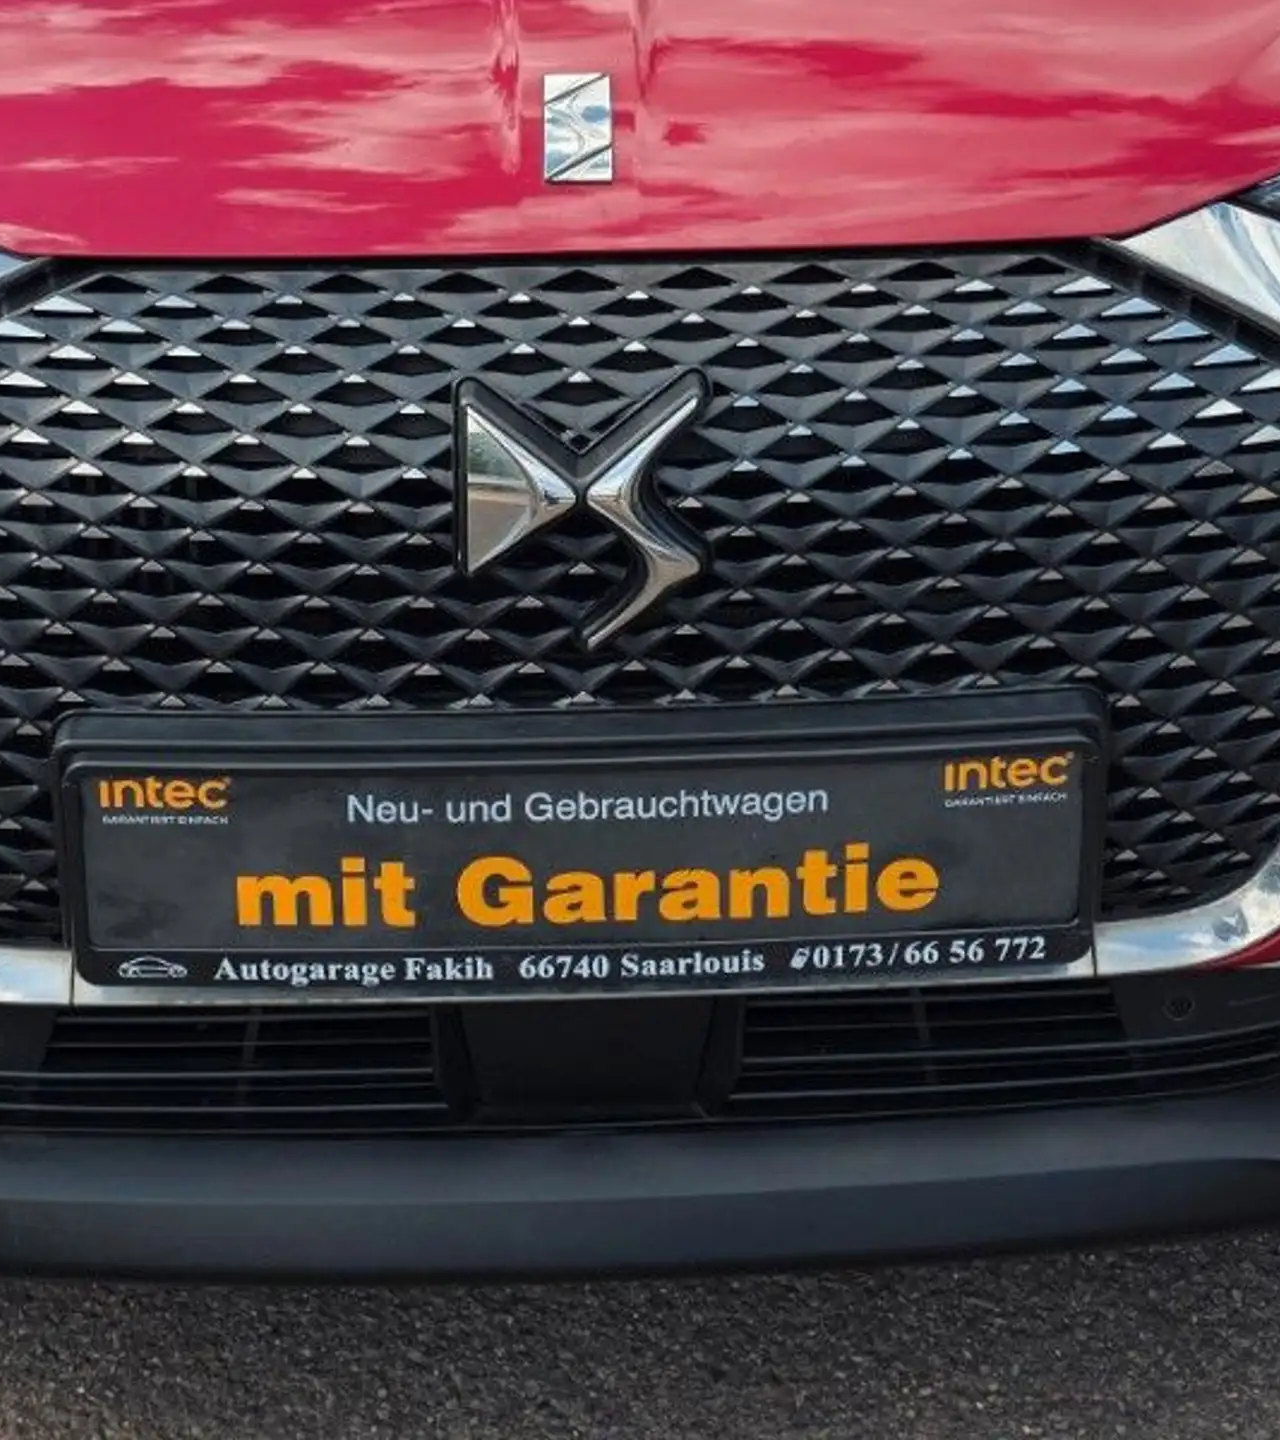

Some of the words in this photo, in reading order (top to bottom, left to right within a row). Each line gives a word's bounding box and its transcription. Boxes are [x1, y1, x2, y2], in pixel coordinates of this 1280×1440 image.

[944, 756, 1069, 792] intec
[99, 776, 228, 809] intec
[347, 793, 433, 823] Neu-
[446, 794, 512, 822] und
[524, 788, 828, 822] Gebrauchtwagen
[236, 857, 416, 927] mit
[457, 843, 940, 926] Garantie
[214, 957, 396, 987] Autogarage
[403, 955, 494, 981] Fakih
[519, 953, 610, 979] 66740
[620, 947, 766, 977] Saarlouis
[947, 936, 985, 962] 56
[994, 934, 1047, 961] 772
